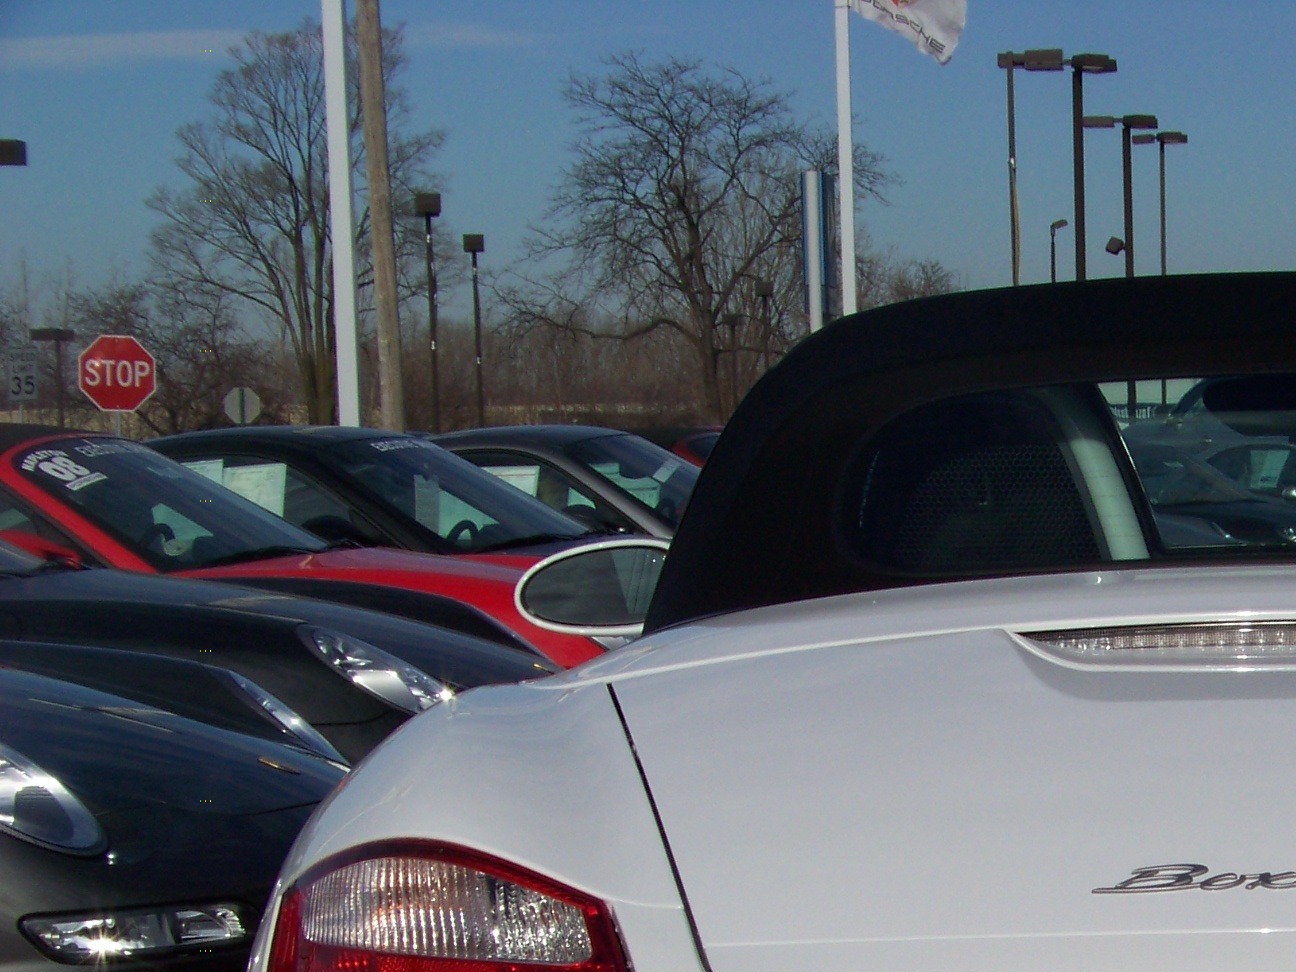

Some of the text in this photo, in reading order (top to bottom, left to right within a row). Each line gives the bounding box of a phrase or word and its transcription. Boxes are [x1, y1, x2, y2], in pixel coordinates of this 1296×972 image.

[860, 0, 945, 53] RSCHE
[11, 375, 35, 395] 35
[85, 359, 150, 387] STOP
[38, 456, 91, 481] 08
